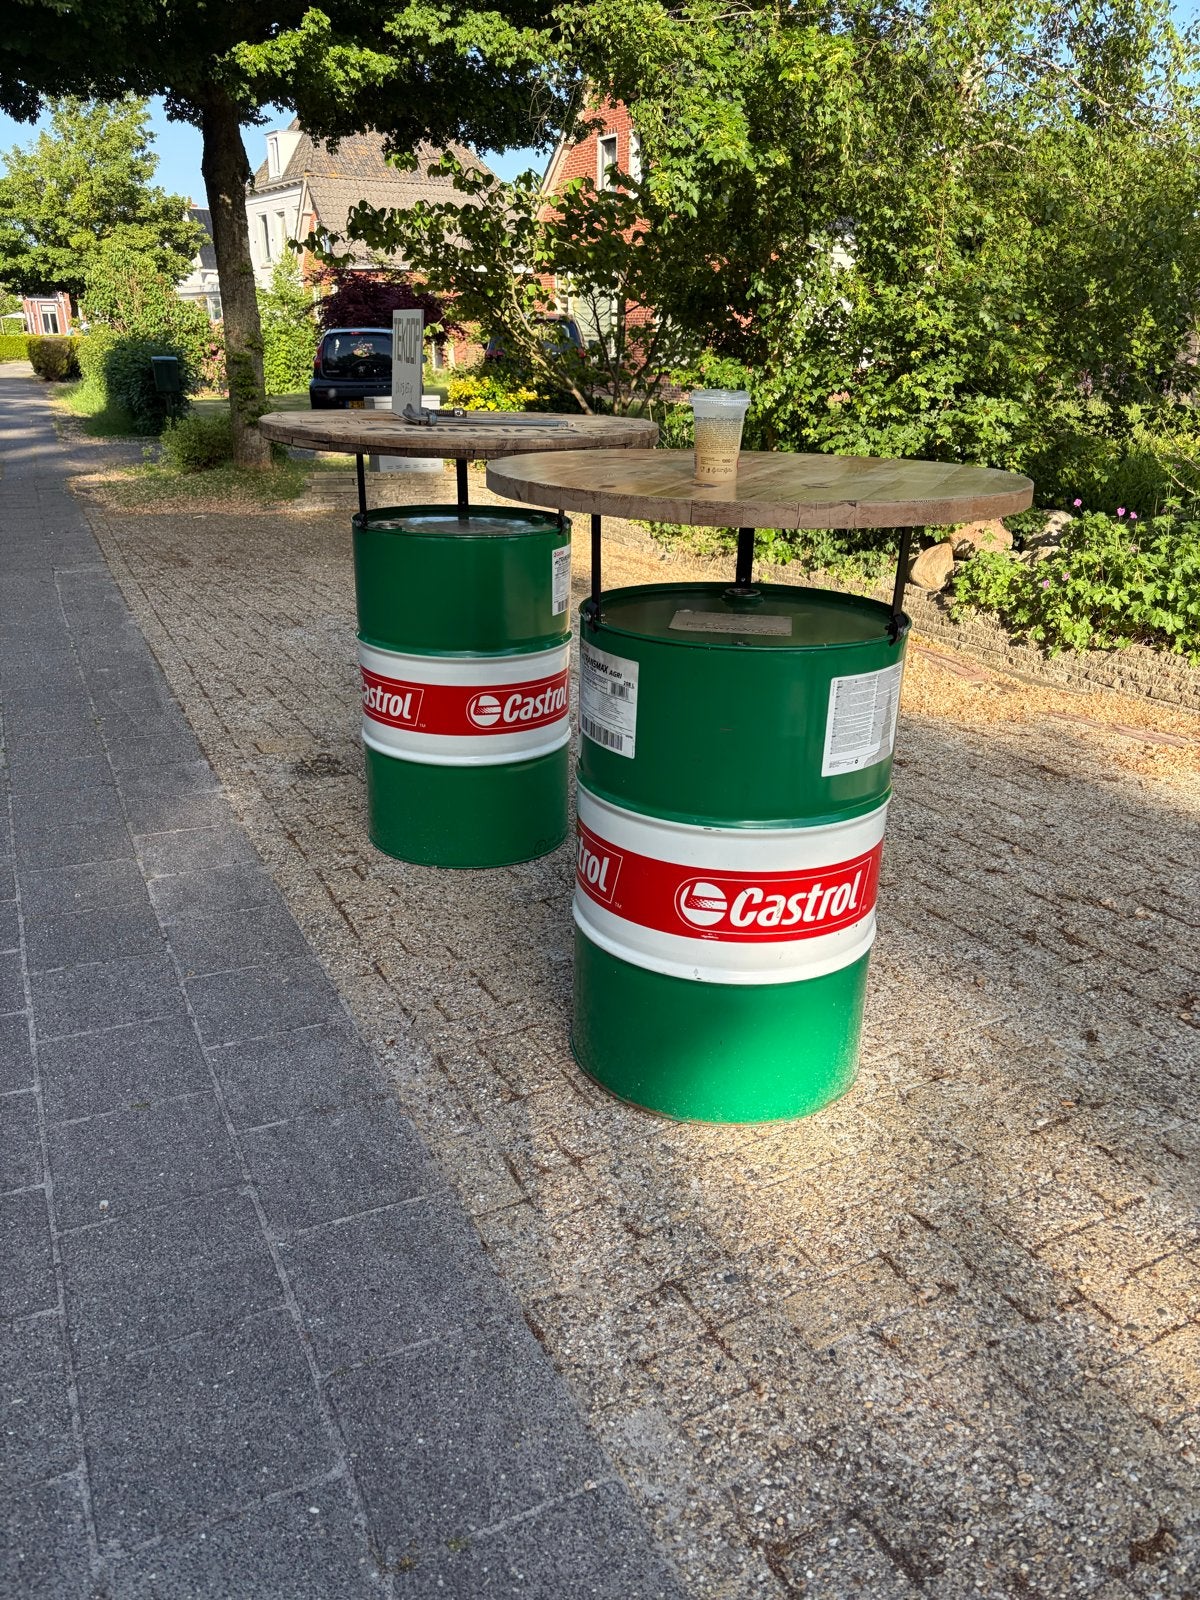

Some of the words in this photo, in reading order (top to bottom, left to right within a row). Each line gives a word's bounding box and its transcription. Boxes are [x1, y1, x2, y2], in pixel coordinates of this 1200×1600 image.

[608, 669, 623, 679] AGRI
[362, 683, 413, 719] astrol
[503, 679, 567, 723] Castrol
[577, 836, 610, 893] trol
[729, 869, 863, 927] Castrol
